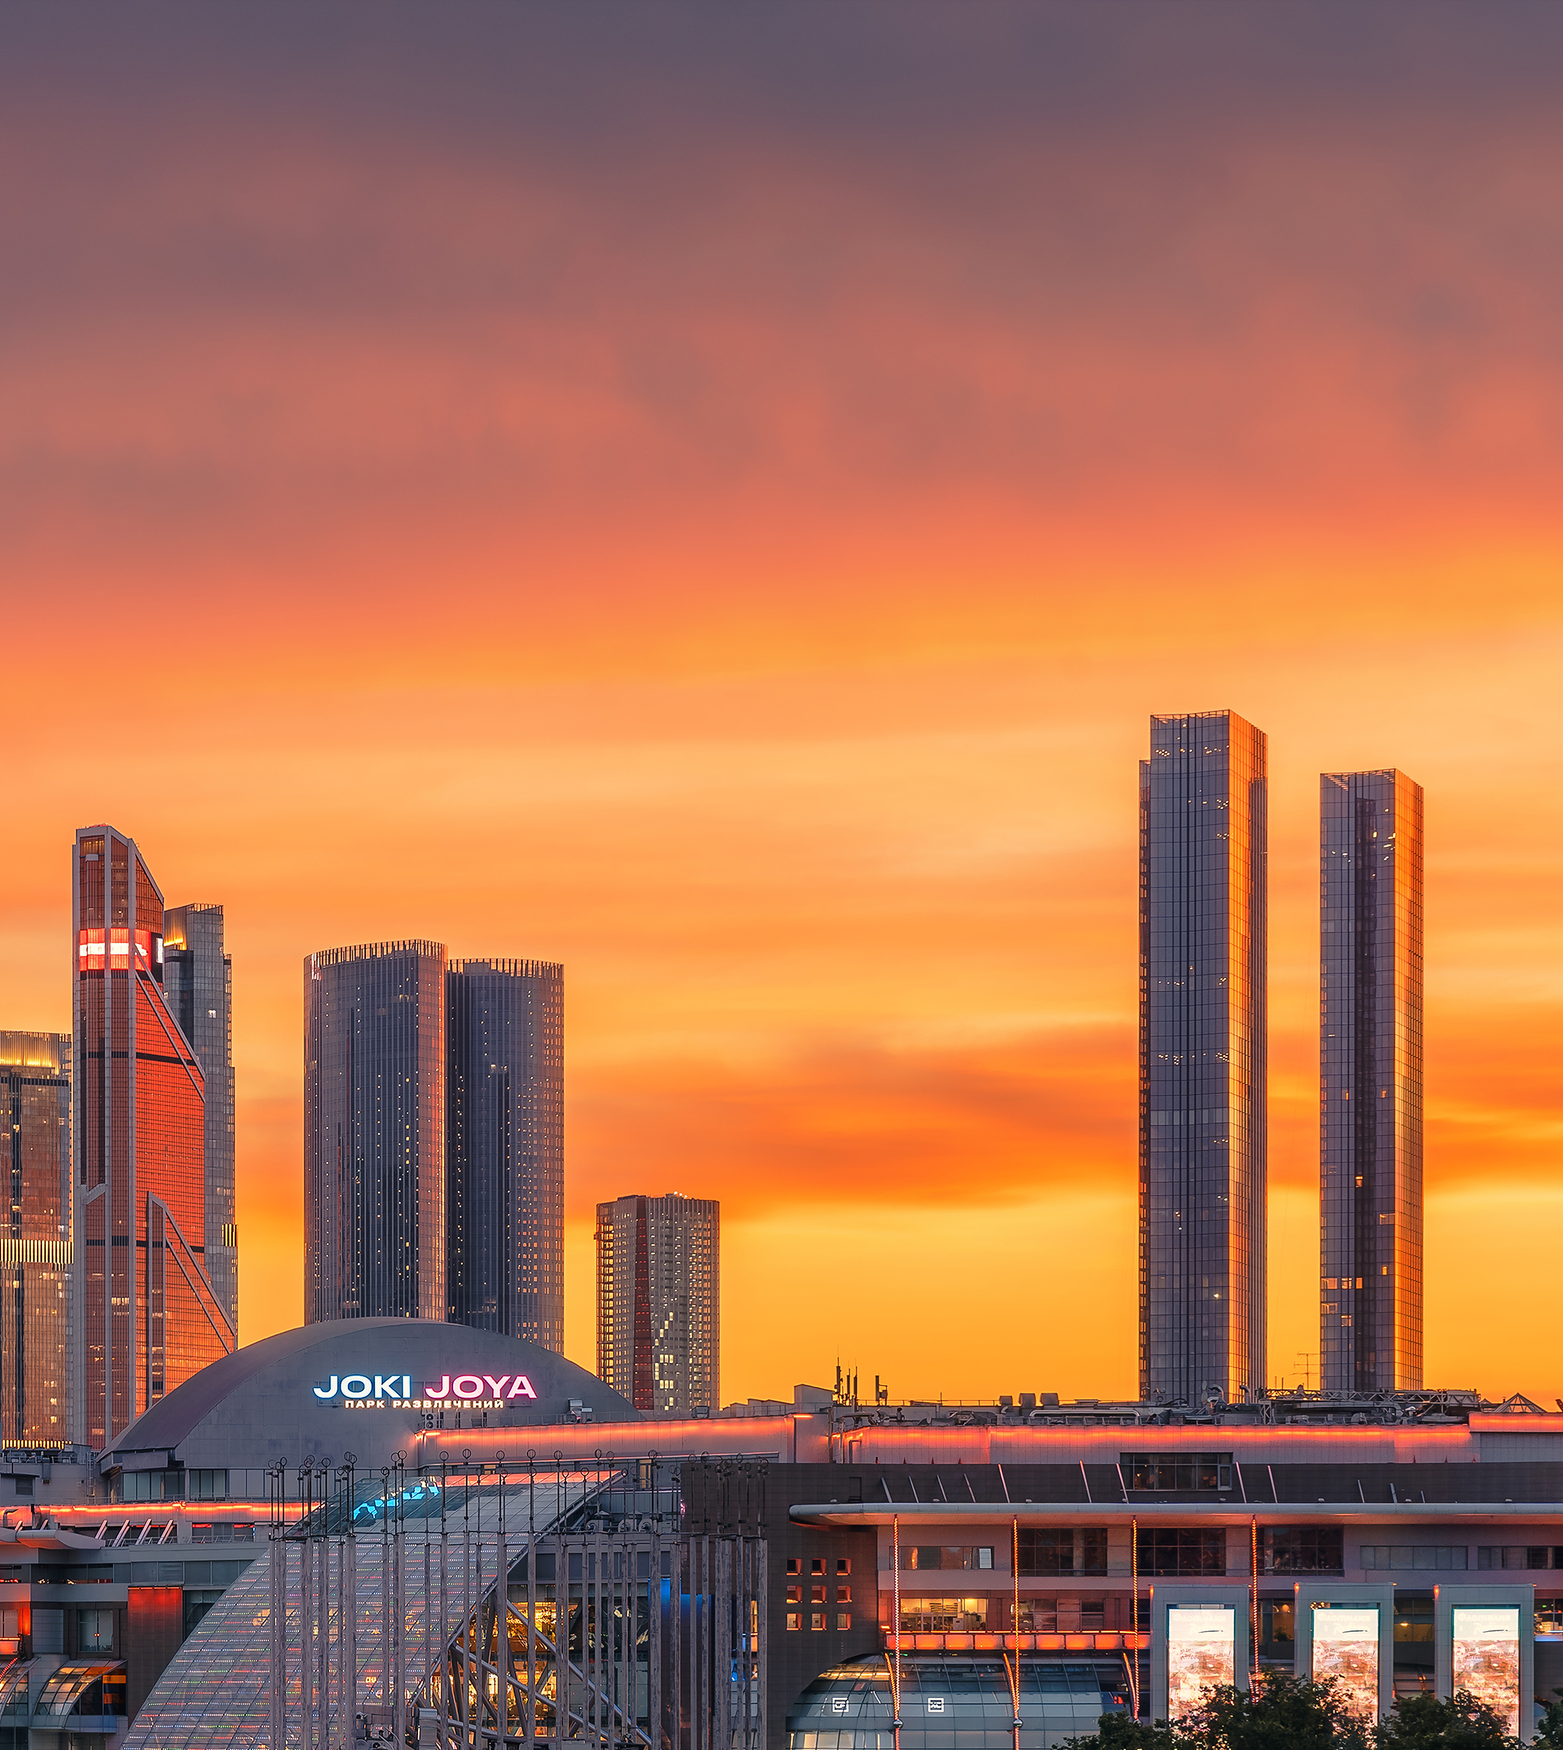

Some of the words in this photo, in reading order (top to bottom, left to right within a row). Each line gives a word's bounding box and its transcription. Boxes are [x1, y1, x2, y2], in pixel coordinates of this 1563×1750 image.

[313, 1375, 411, 1399] JOKI
[425, 1375, 537, 1399] JOYA
[345, 1400, 385, 1408] ПАРК
[392, 1400, 504, 1408] РАЗВЛЕЧЕНИЙ
